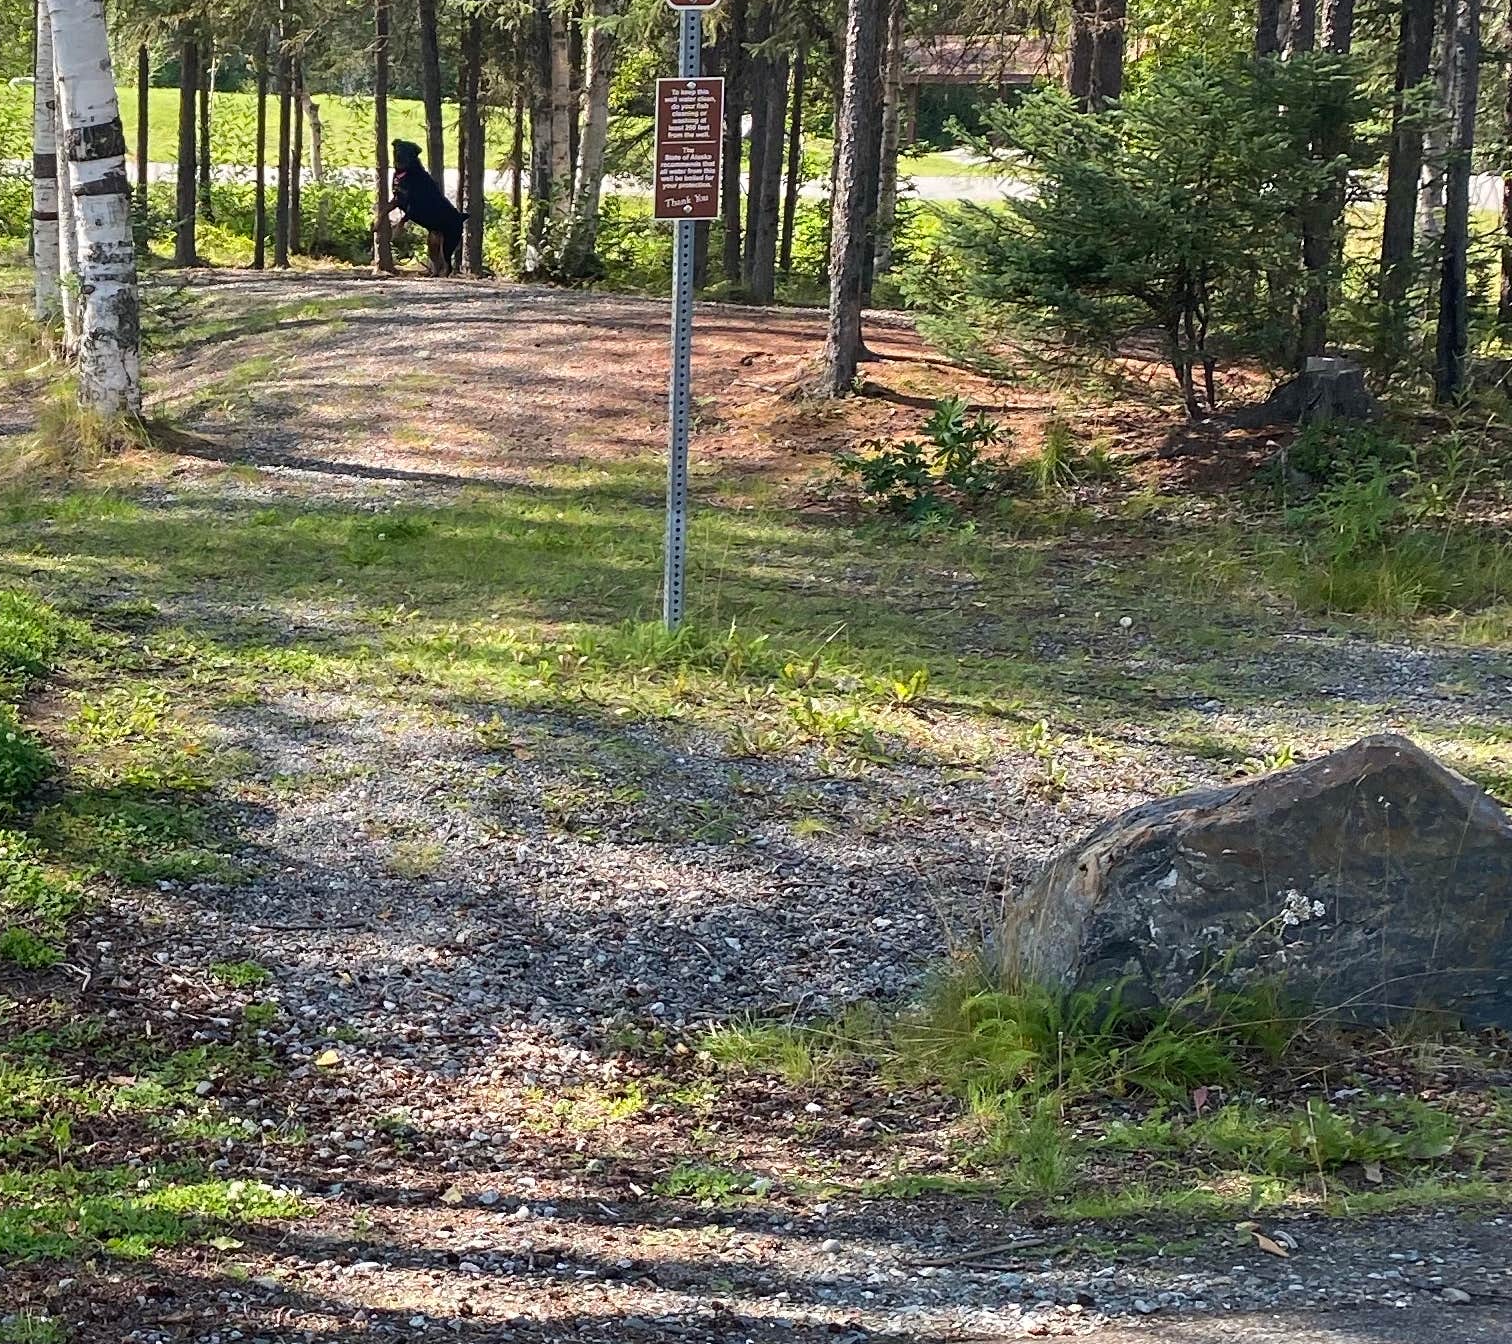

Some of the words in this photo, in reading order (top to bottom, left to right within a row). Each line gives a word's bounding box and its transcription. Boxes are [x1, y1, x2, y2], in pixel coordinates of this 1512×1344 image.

[697, 88, 710, 96] this
[680, 103, 696, 111] your
[671, 110, 700, 118] cleaning
[689, 153, 713, 161] Alaska
[664, 195, 692, 208] Thank
[694, 193, 710, 203] You
